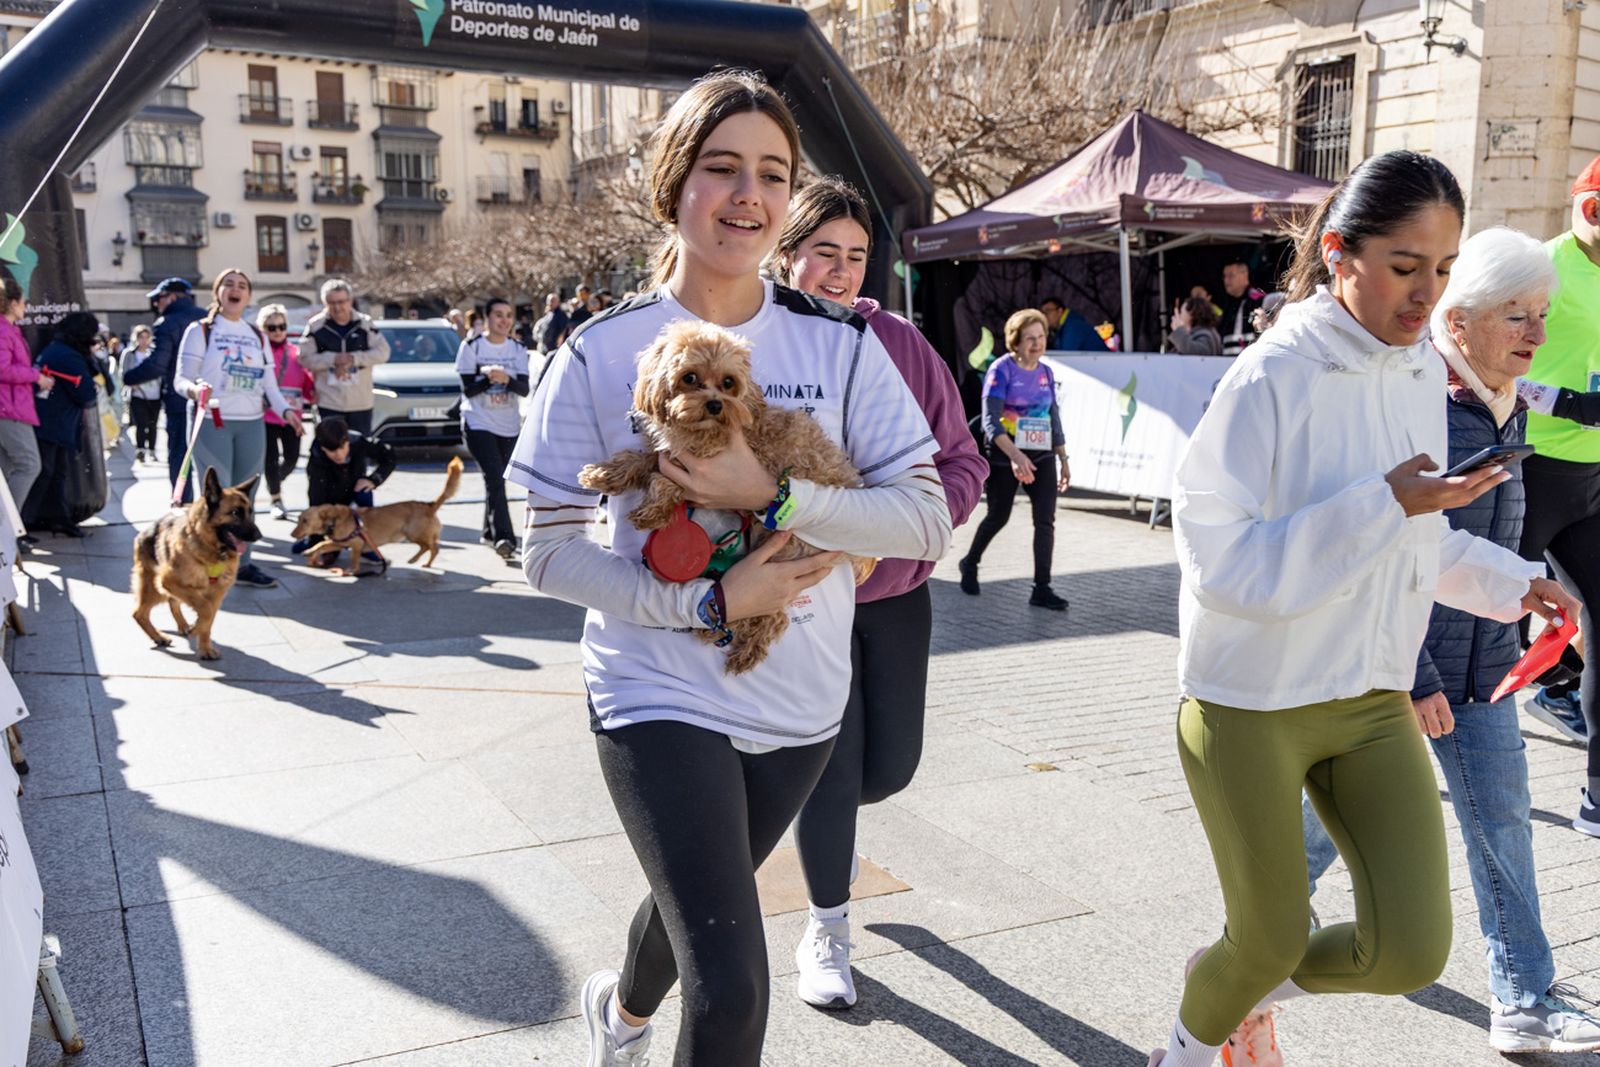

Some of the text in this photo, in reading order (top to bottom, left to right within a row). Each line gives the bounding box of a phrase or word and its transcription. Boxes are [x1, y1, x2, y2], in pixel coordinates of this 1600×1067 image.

[450, 15, 598, 47] Deportes de Jaén
[451, 0, 640, 31] Patronato Municipal de
